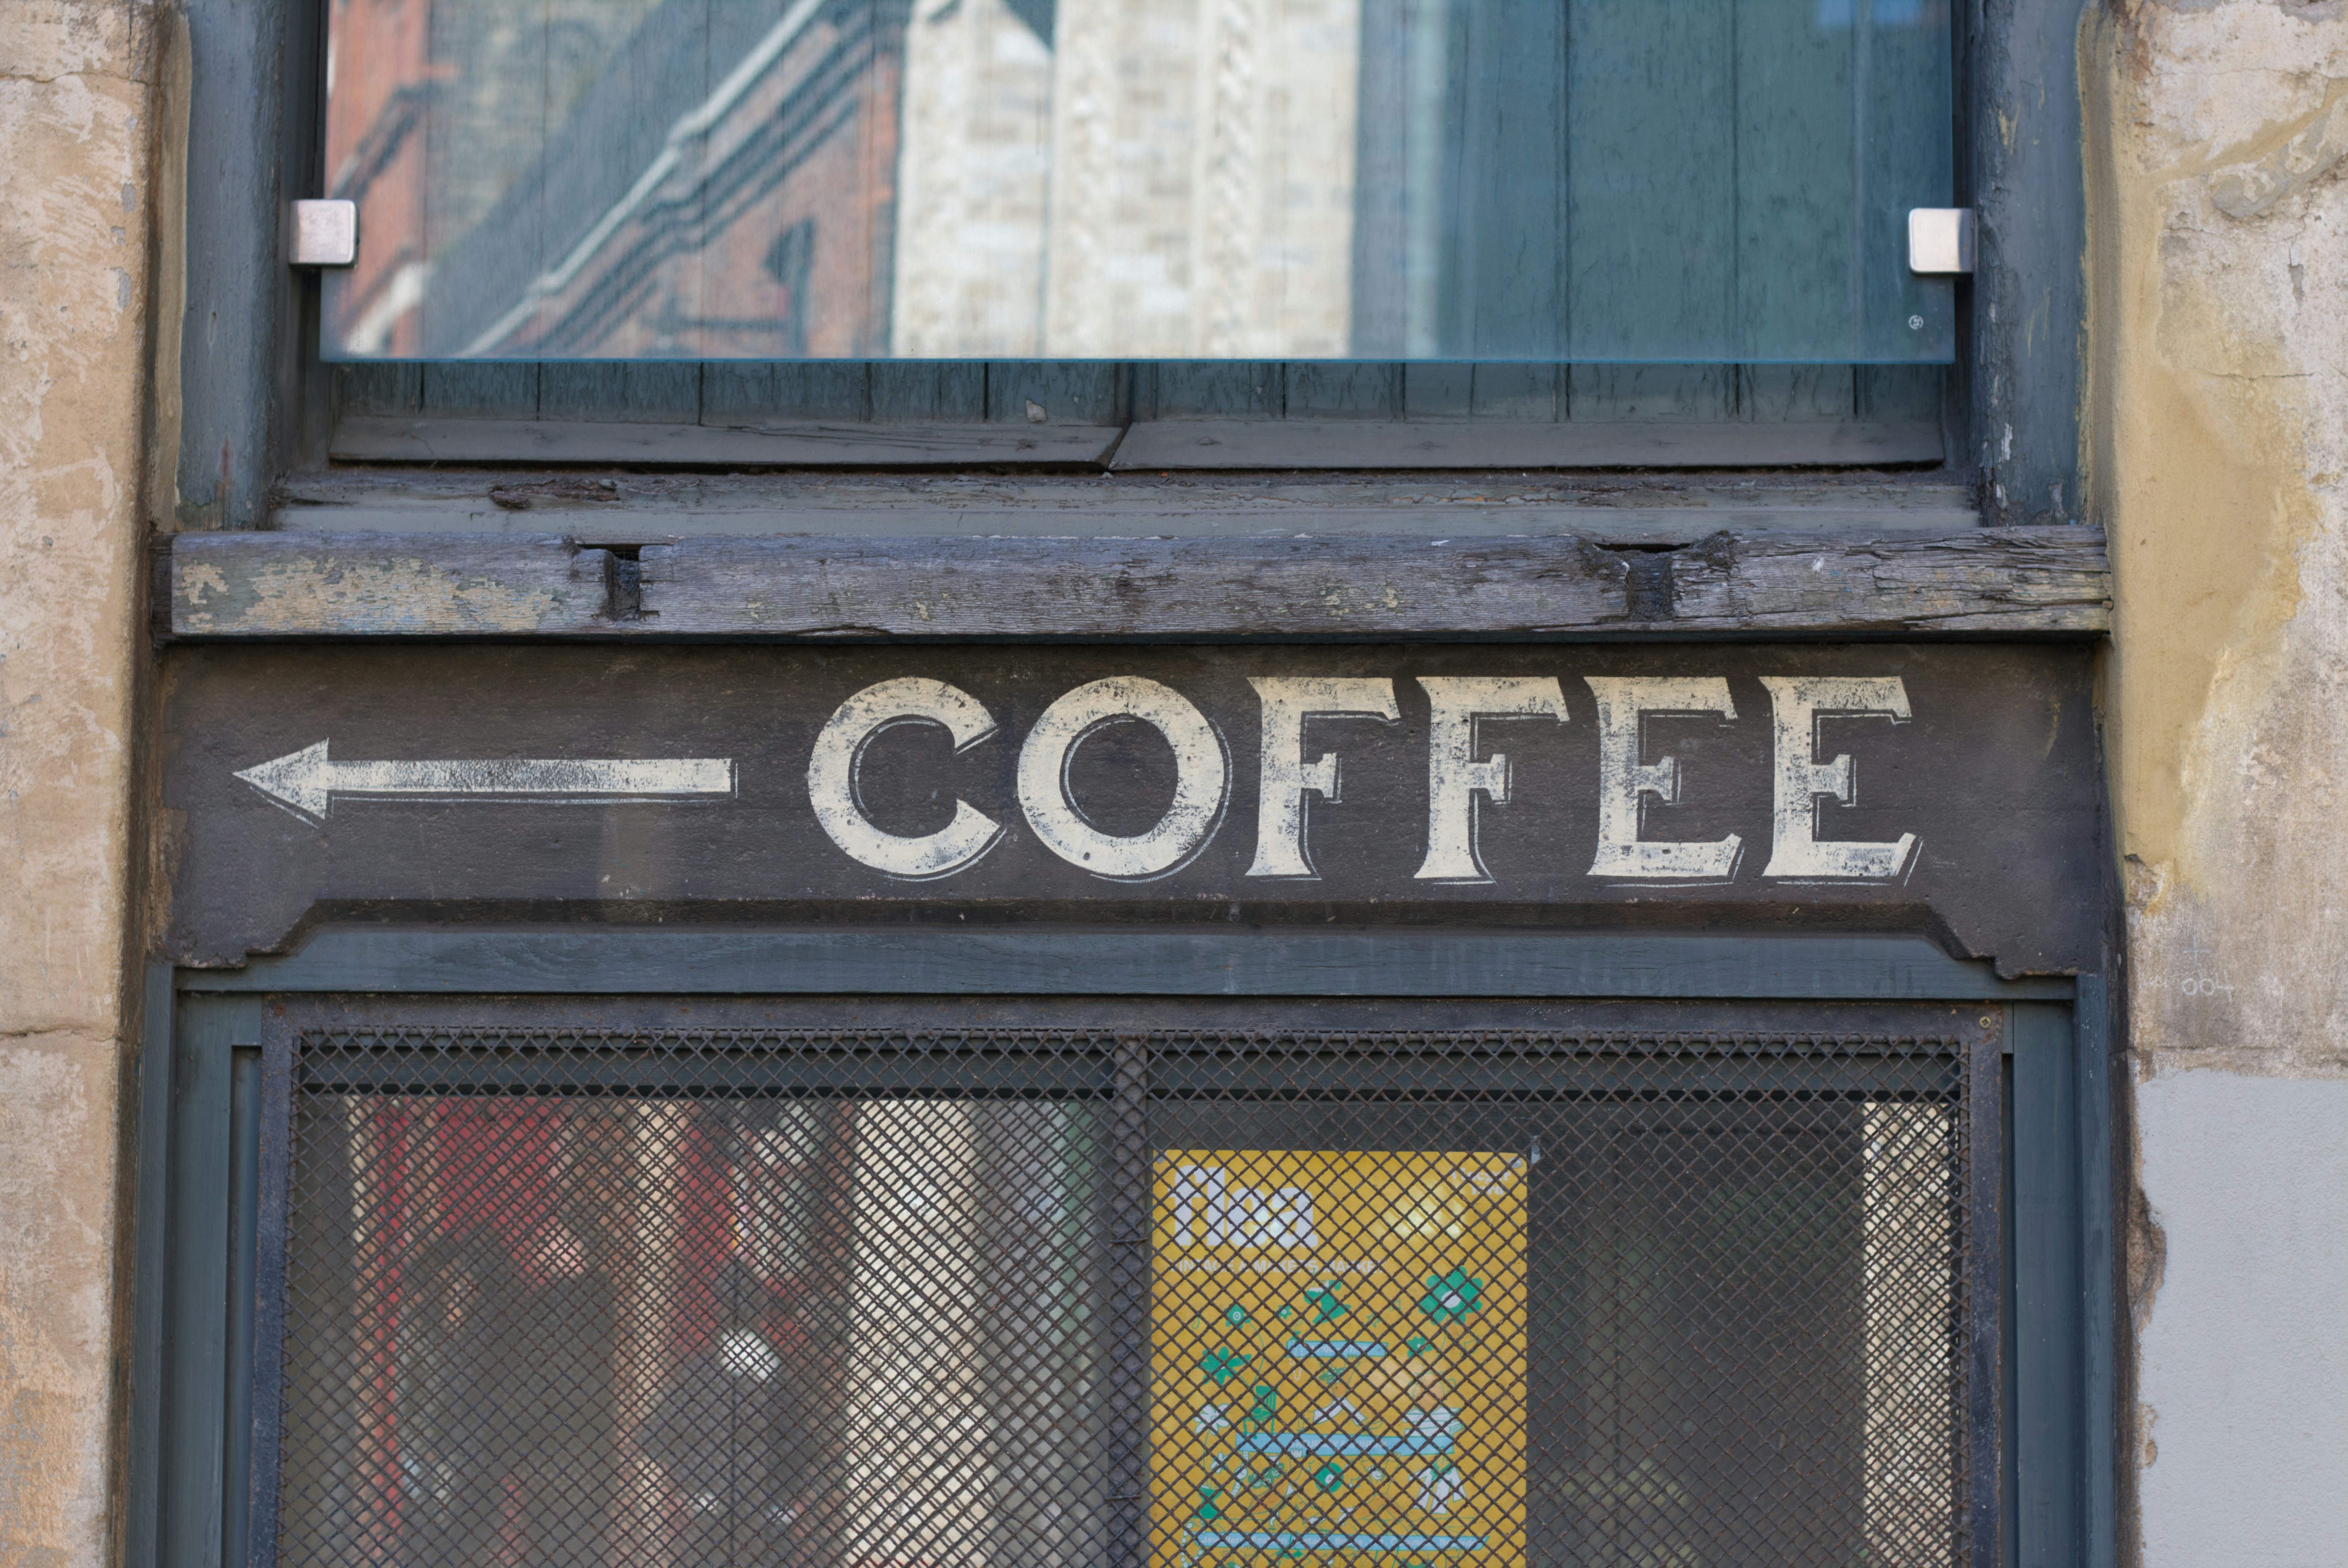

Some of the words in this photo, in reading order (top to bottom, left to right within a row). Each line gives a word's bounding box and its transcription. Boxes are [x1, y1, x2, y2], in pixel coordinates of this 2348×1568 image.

[808, 676, 1920, 884] COFFEE
[1449, 1167, 1511, 1184] Viegr
[1469, 1182, 1505, 1195] Yrd
[1168, 1165, 1318, 1248] flea
[1201, 1536, 1244, 1545] Jewllery
[1252, 1536, 1287, 1544] Fasn
